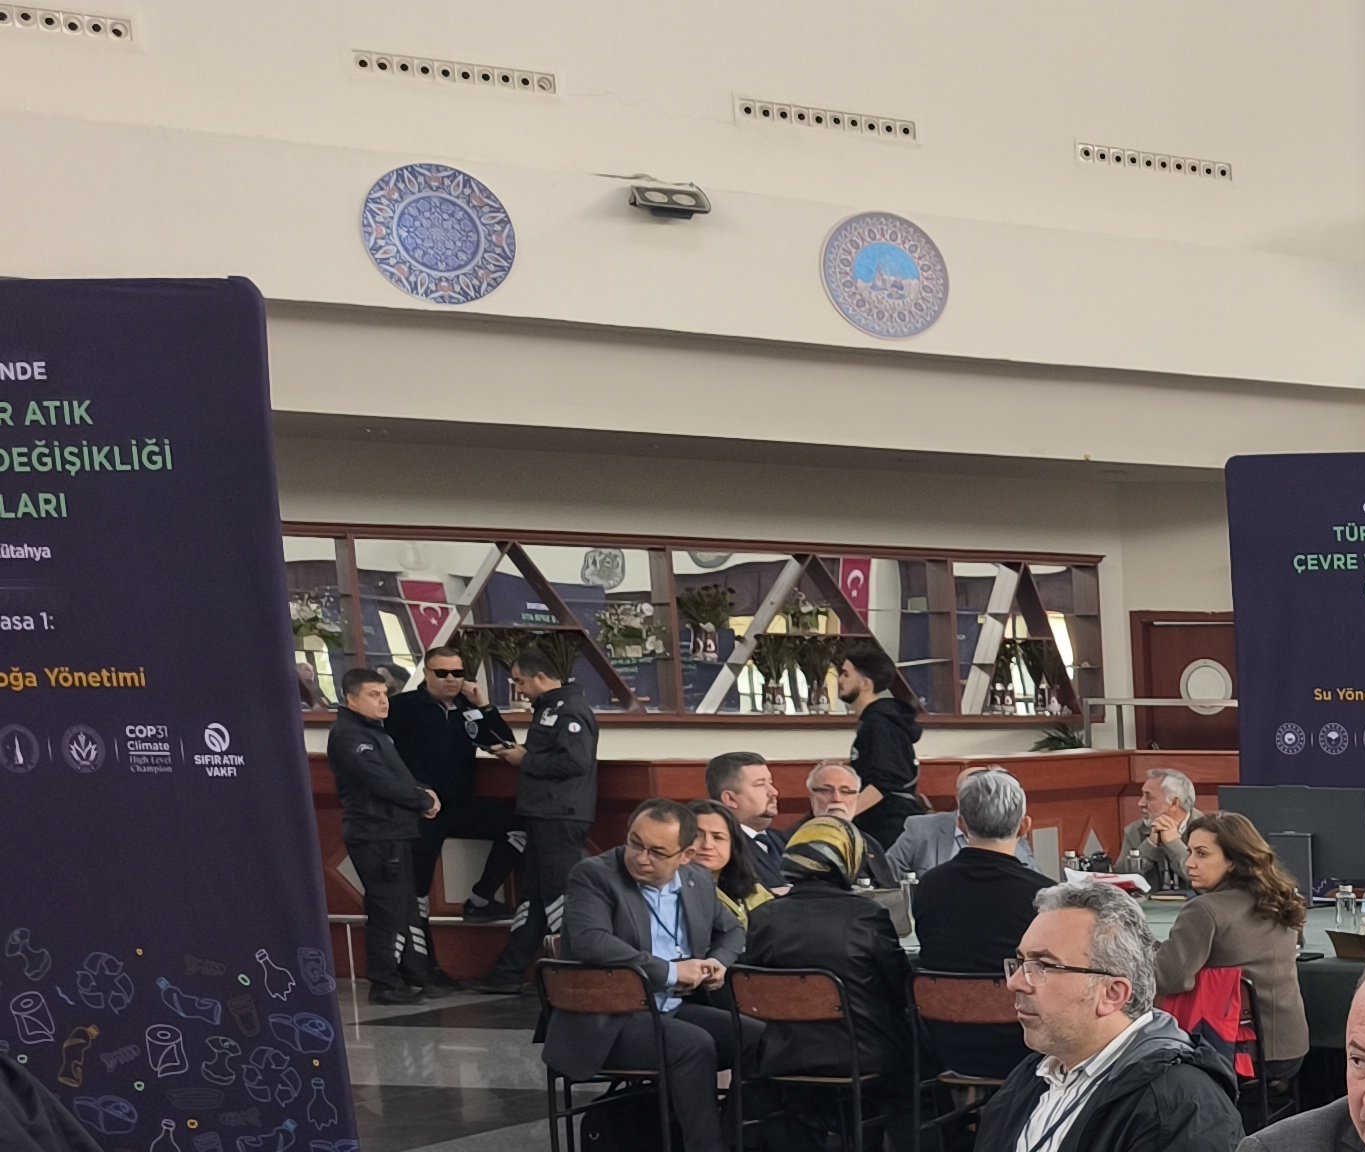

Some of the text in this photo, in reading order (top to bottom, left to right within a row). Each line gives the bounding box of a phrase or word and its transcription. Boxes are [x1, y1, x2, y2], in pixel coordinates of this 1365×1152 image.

[24, 400, 94, 426] ATIK
[1293, 553, 1359, 574] ÇEVRE
[40, 611, 54, 630] 1:
[44, 667, 147, 688] Yönetimi
[1313, 687, 1333, 702] Su
[125, 725, 169, 738] COP31
[127, 740, 170, 751] Climate
[194, 755, 245, 765] SIFIR ATIK
[205, 767, 237, 777] VAKFI
